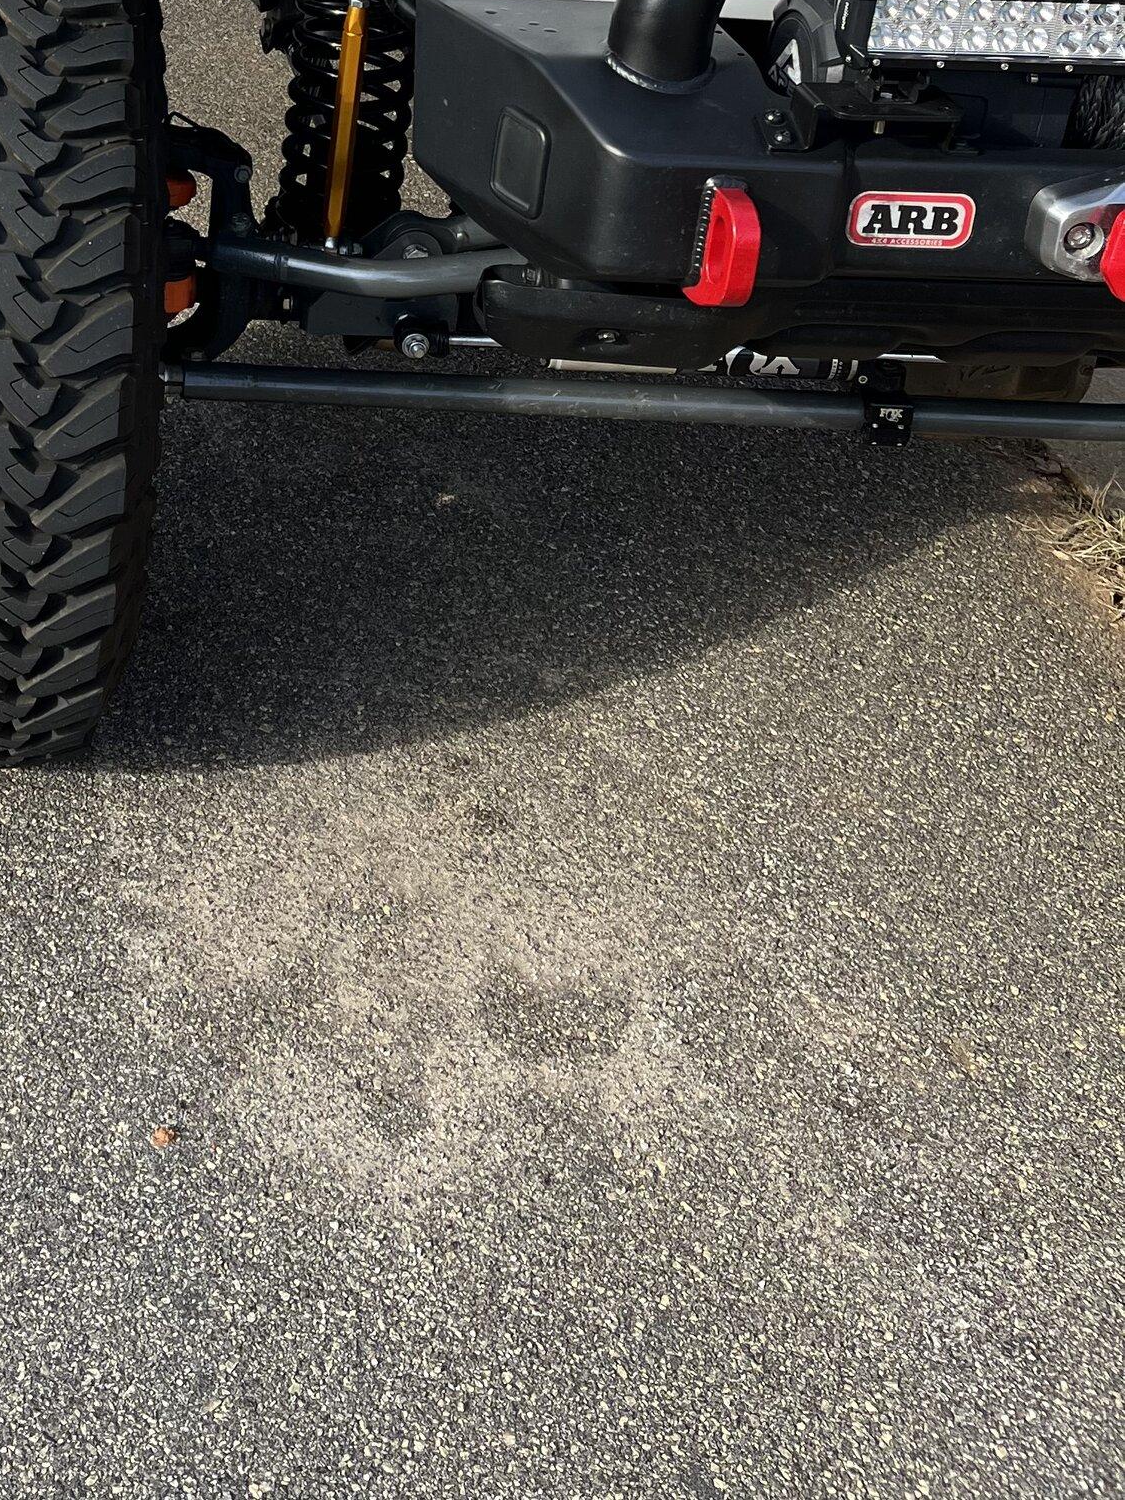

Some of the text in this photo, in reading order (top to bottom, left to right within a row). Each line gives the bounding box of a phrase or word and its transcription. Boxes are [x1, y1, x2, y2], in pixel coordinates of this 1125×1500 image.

[861, 203, 960, 236] ARB
[889, 238, 943, 247] ACCESSORIES
[879, 407, 904, 423] FOX
